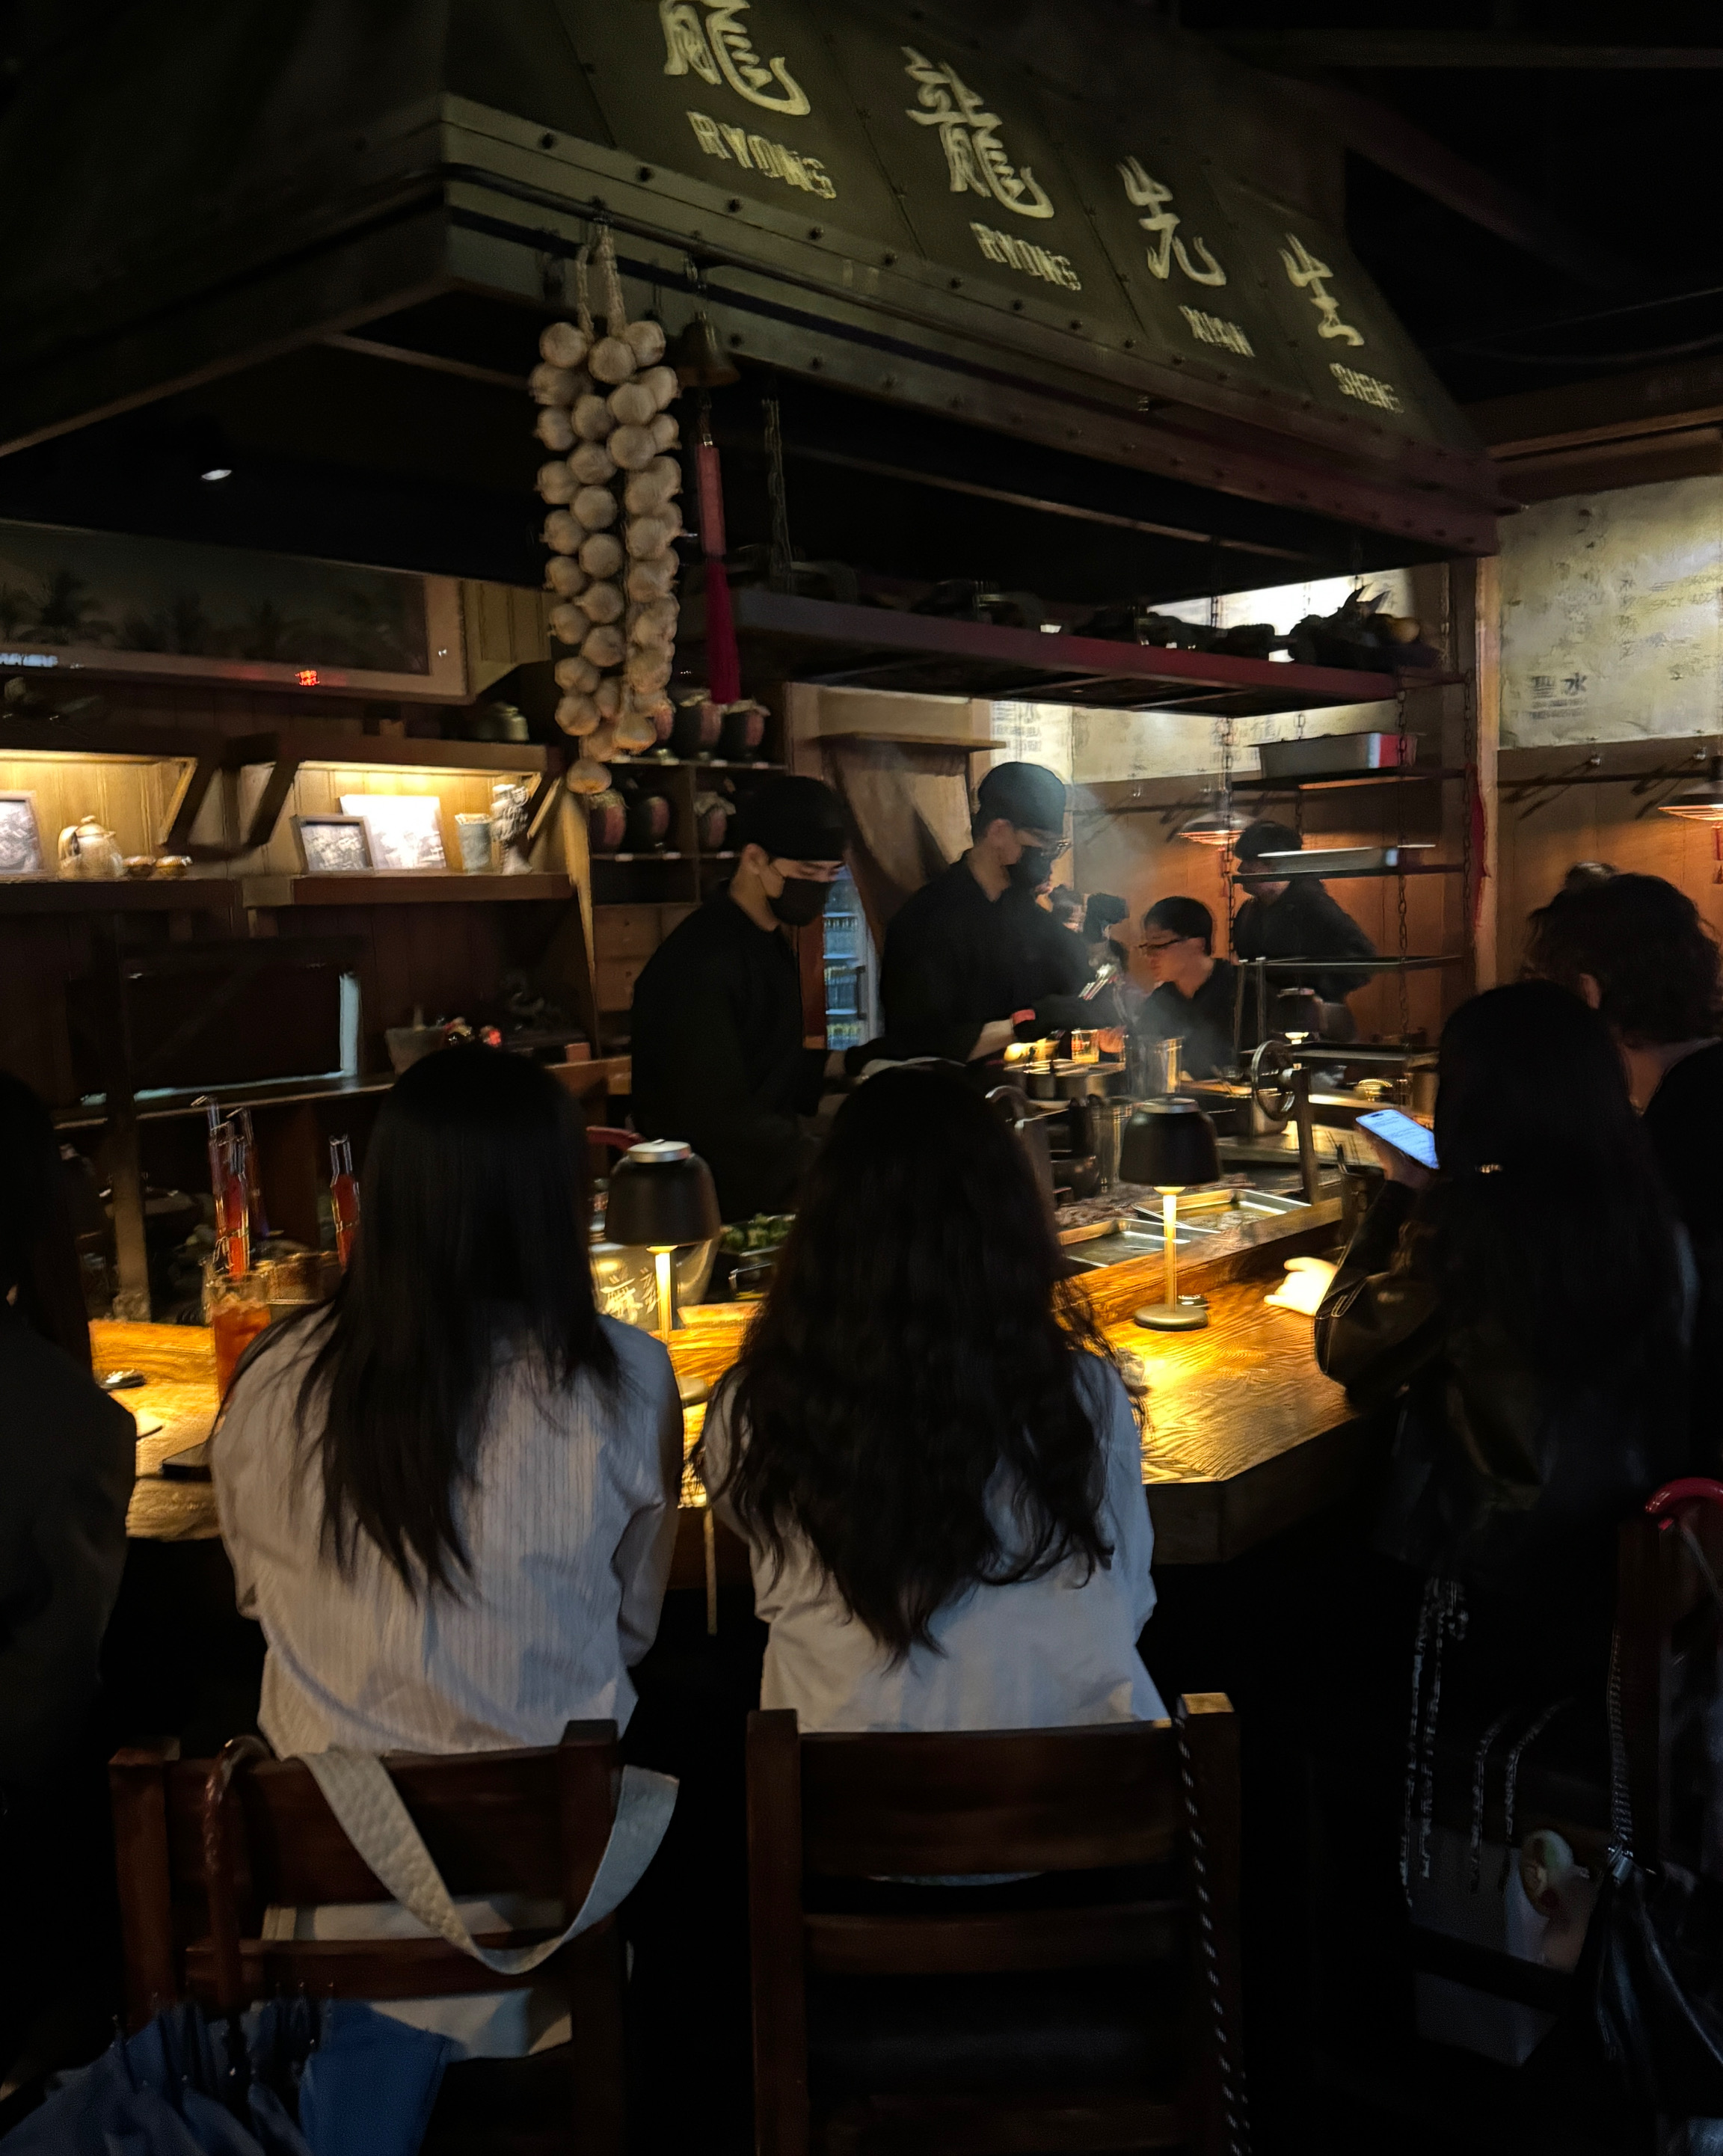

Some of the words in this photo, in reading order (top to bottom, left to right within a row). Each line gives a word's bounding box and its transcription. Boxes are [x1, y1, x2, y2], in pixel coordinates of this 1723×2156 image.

[901, 46, 1054, 218] 龍
[1118, 156, 1226, 286] 先
[1280, 233, 1364, 345] 生
